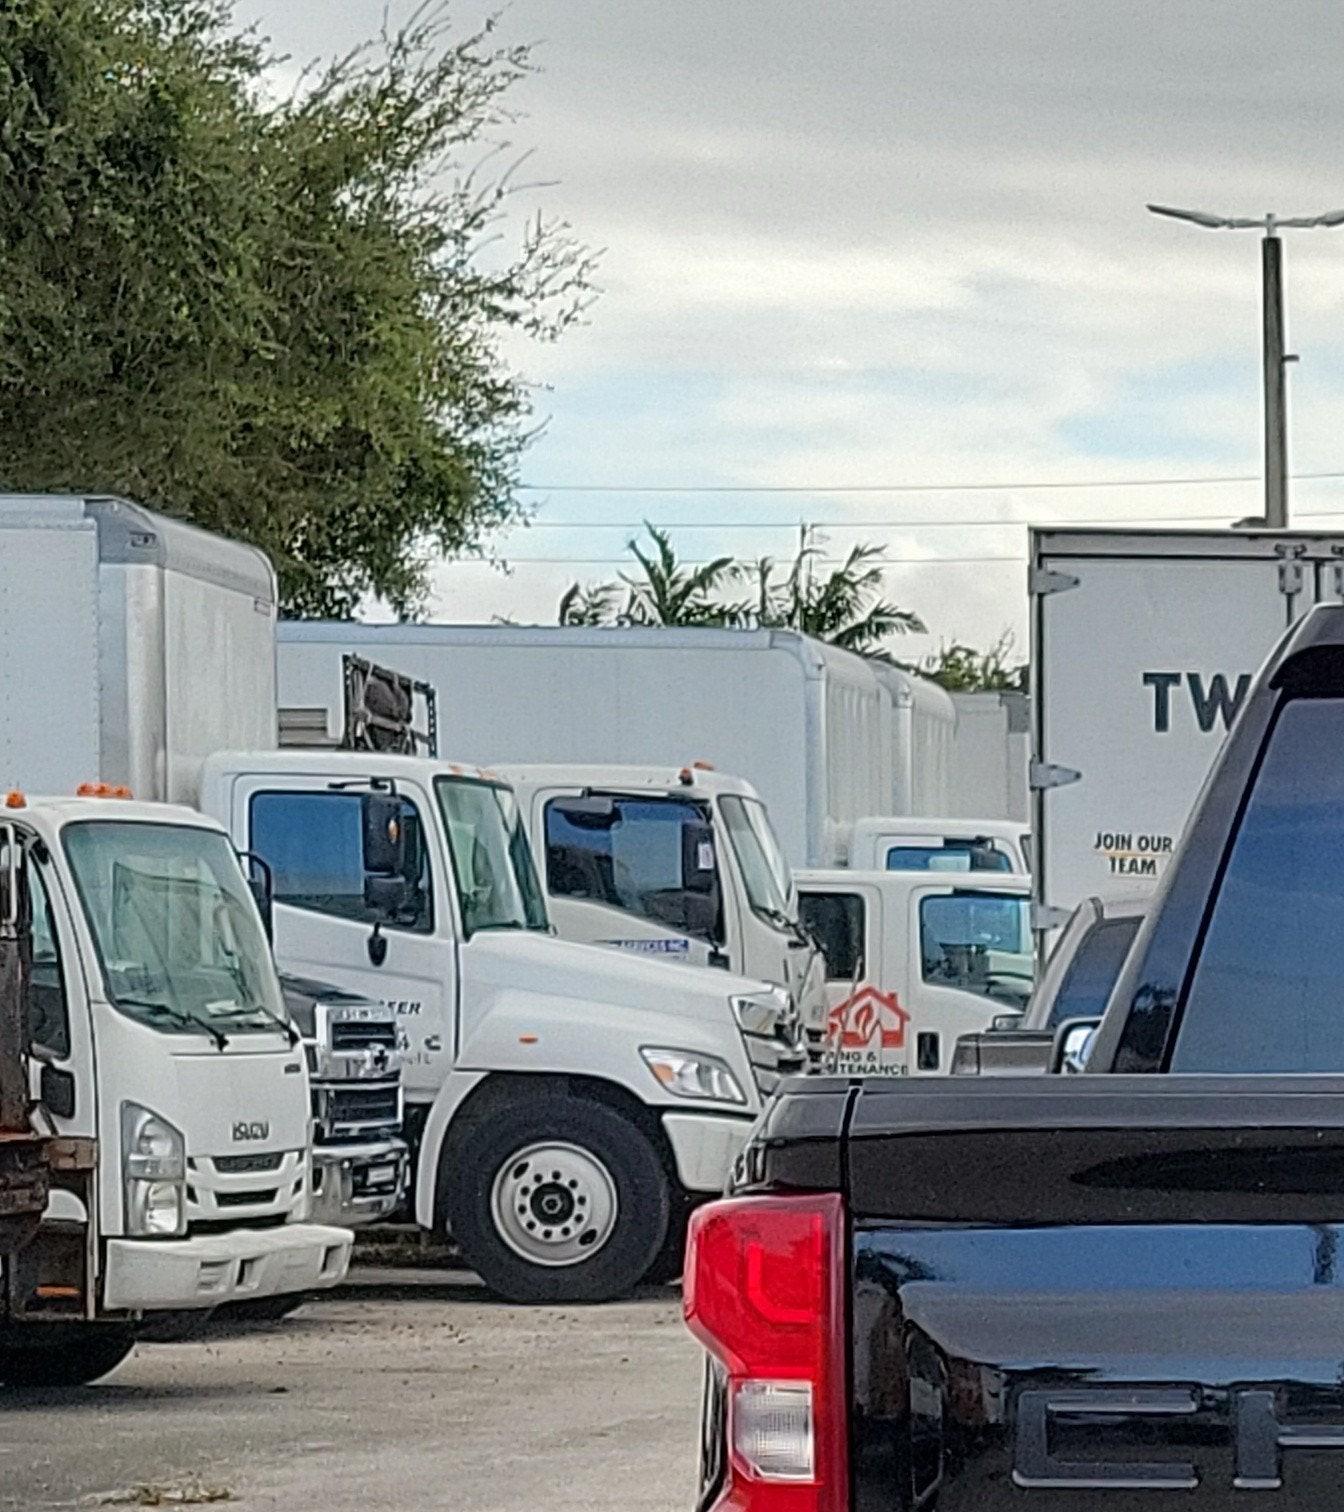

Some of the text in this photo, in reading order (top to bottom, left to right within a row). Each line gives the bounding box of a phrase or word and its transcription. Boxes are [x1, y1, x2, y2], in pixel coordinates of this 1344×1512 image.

[1143, 672, 1252, 732] TW
[1095, 833, 1173, 852] JOIN OUR
[1110, 856, 1156, 874] TEAM
